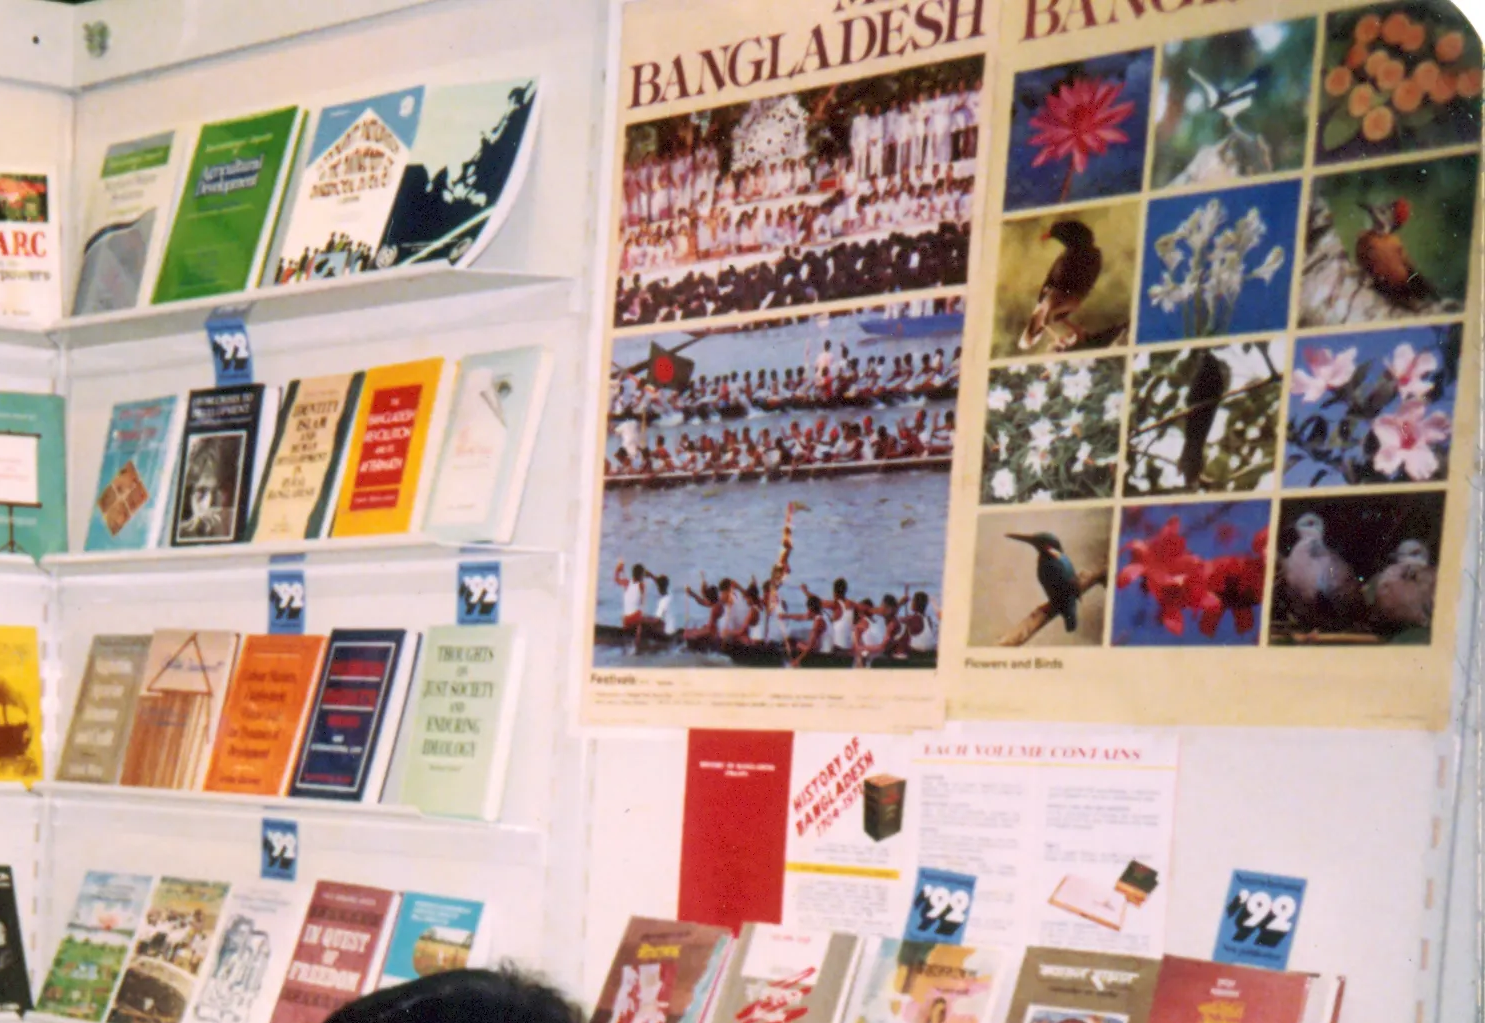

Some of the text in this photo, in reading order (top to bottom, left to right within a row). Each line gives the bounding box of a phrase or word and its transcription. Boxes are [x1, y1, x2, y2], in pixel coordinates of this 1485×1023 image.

[626, 0, 986, 110] BANGLADESH
[213, 332, 250, 362] '92
[271, 580, 305, 613] '92
[460, 572, 499, 607] '92
[437, 646, 495, 664] THOUGHTS
[964, 657, 1064, 671] Flowers and Birds
[450, 681, 495, 699] SOCIETY
[590, 673, 637, 686] Festivals
[425, 717, 481, 735] ENDURING
[421, 738, 478, 758] IDEOLOGY
[975, 743, 1044, 759] VOLUME
[1050, 746, 1142, 761] CONTAINS
[793, 736, 860, 814] HISTORY OF
[795, 749, 875, 838] BANGLADESH
[264, 827, 298, 862] '92
[920, 884, 970, 928] '92
[1233, 888, 1297, 938] '92
[322, 926, 371, 953] QUEST
[288, 960, 362, 992] FREEDOM
